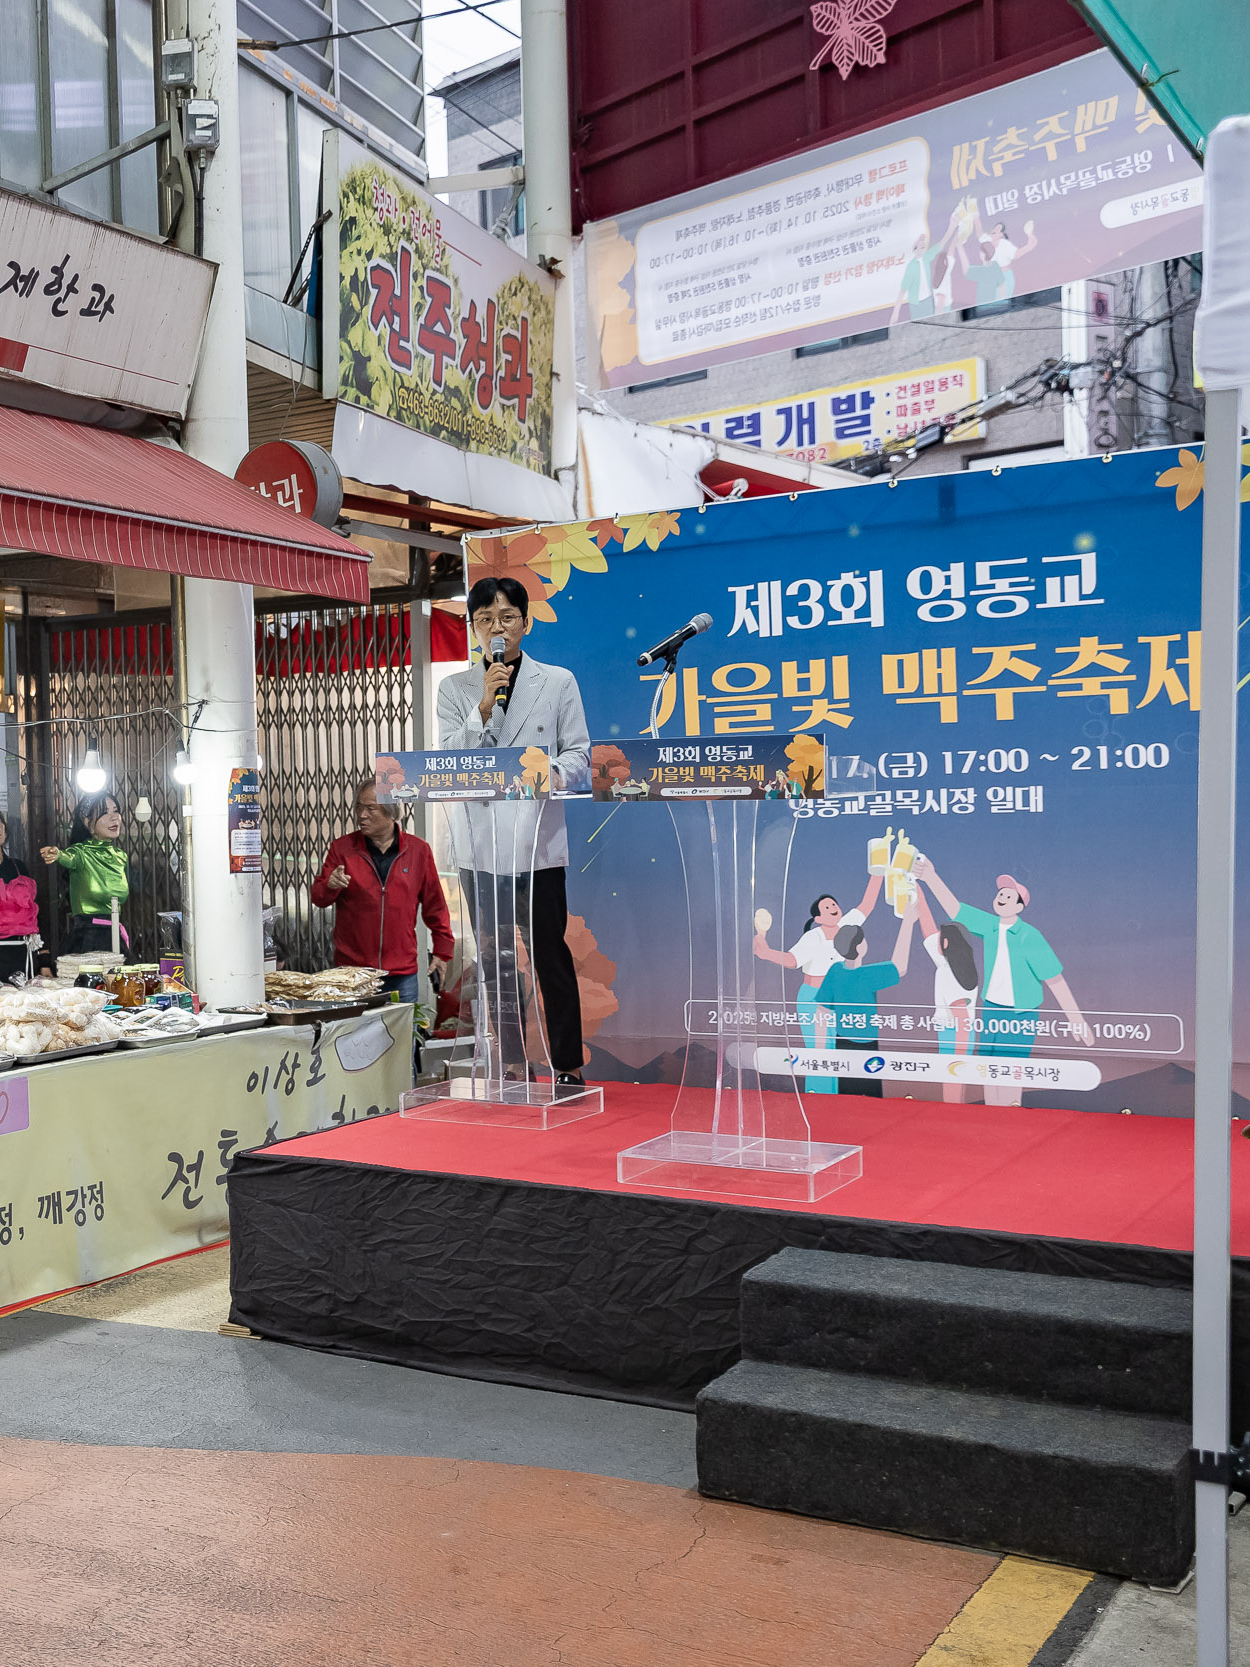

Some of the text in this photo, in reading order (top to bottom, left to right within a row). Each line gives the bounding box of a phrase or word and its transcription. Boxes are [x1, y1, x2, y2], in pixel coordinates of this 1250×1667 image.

[368, 246, 534, 426] 전주청과
[727, 551, 1105, 638] 제3회 영동교
[639, 654, 856, 736] 가을빛
[424, 755, 497, 772] 제3회 영동교
[657, 745, 754, 764] 제3회 영동교
[878, 751, 928, 779] (금)
[942, 748, 1030, 775] 17:00
[1070, 742, 1170, 771] 21:00
[418, 771, 505, 788] 가을빛 맥주축제
[649, 764, 765, 783] 가을빛 맥주축제
[986, 785, 1044, 814] 일대
[760, 1010, 836, 1029] 지방보조사업
[839, 1014, 867, 1030] 선정
[869, 1015, 898, 1031] 축제
[901, 1016, 914, 1031] 총
[917, 1017, 959, 1034] 사업비
[1091, 1024, 1151, 1042] 100%)
[246, 1047, 327, 1097] 이상호
[800, 1059, 1061, 1082] 서울특별시 광진구 영동교골목시장
[37, 1181, 106, 1227] 깨강정
